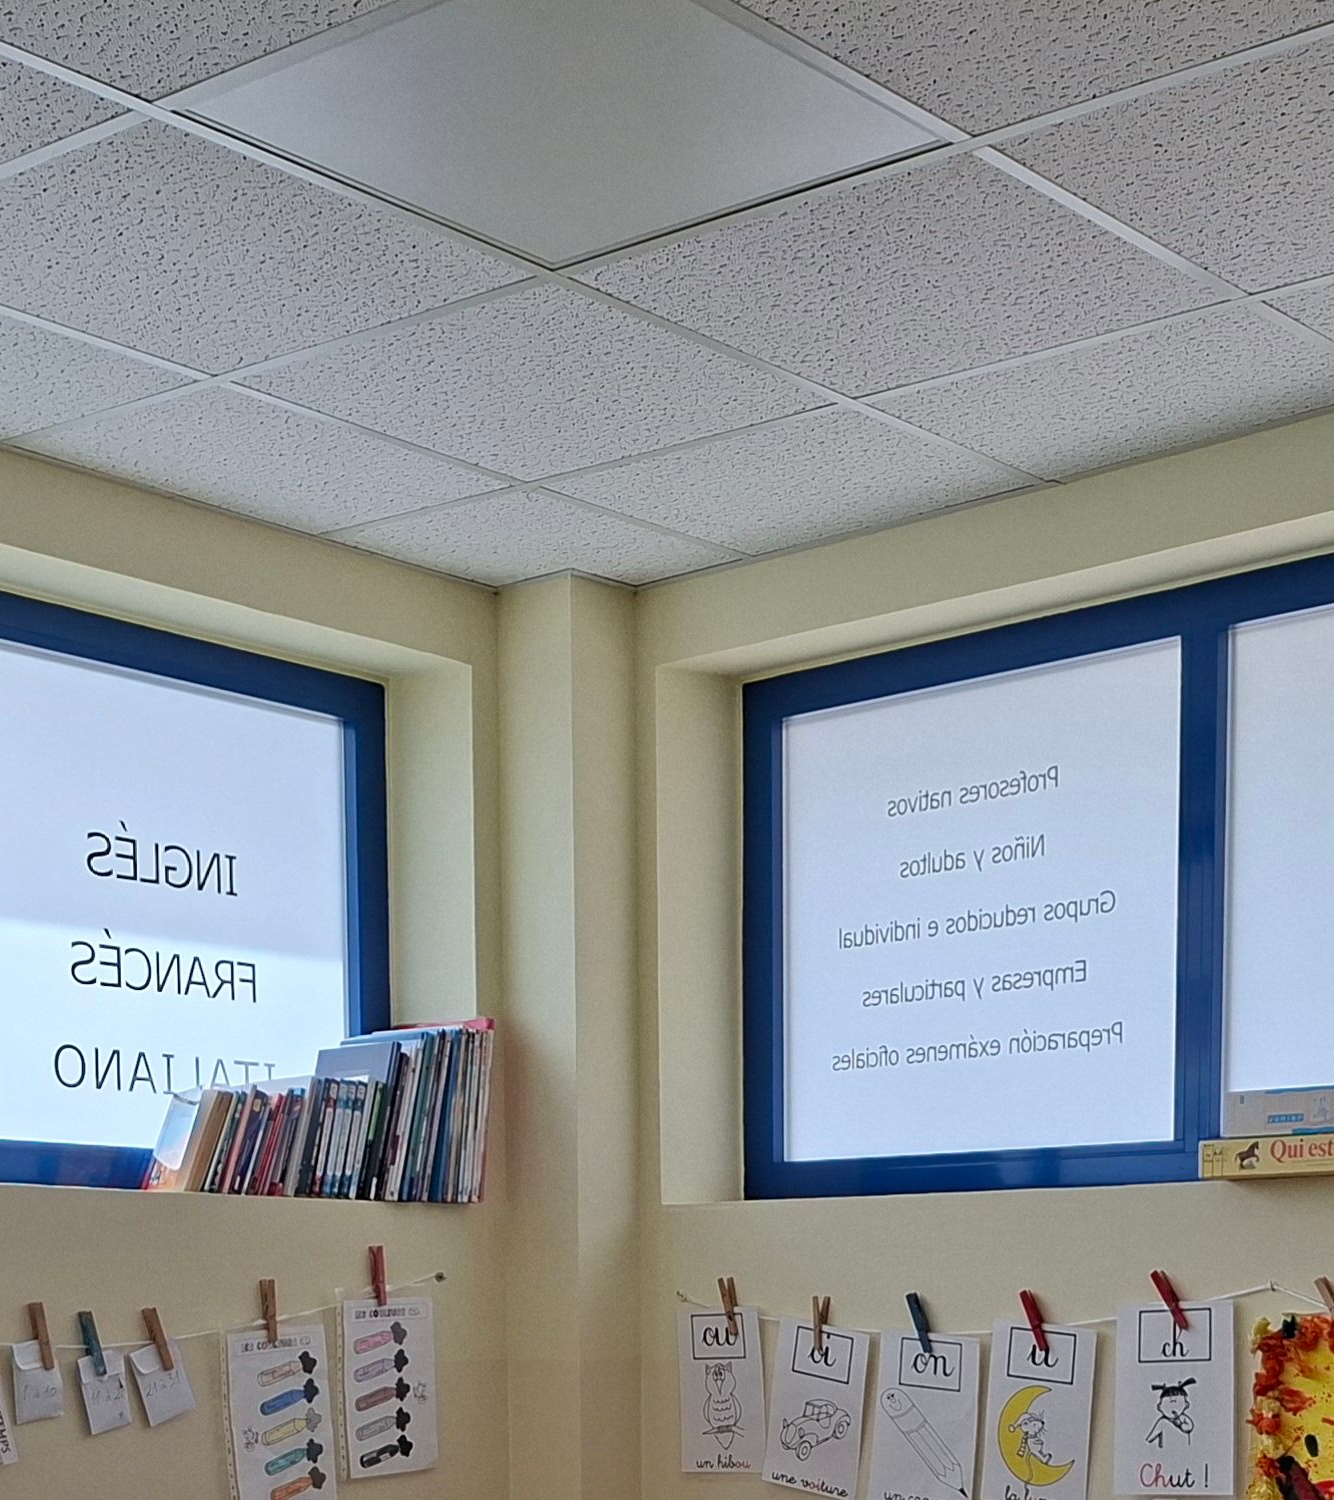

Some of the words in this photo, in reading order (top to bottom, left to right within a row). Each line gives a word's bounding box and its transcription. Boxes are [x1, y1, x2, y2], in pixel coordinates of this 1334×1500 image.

[1270, 1138, 1305, 1163] Qui
[1162, 1319, 1189, 1358] ch
[911, 1351, 954, 1377] on
[696, 1458, 714, 1469] un
[717, 1454, 751, 1470] hibou
[771, 1471, 797, 1485] une
[800, 1478, 849, 1498] voiture
[1140, 1463, 1195, 1488] Chut
[1204, 1463, 1209, 1487] !
